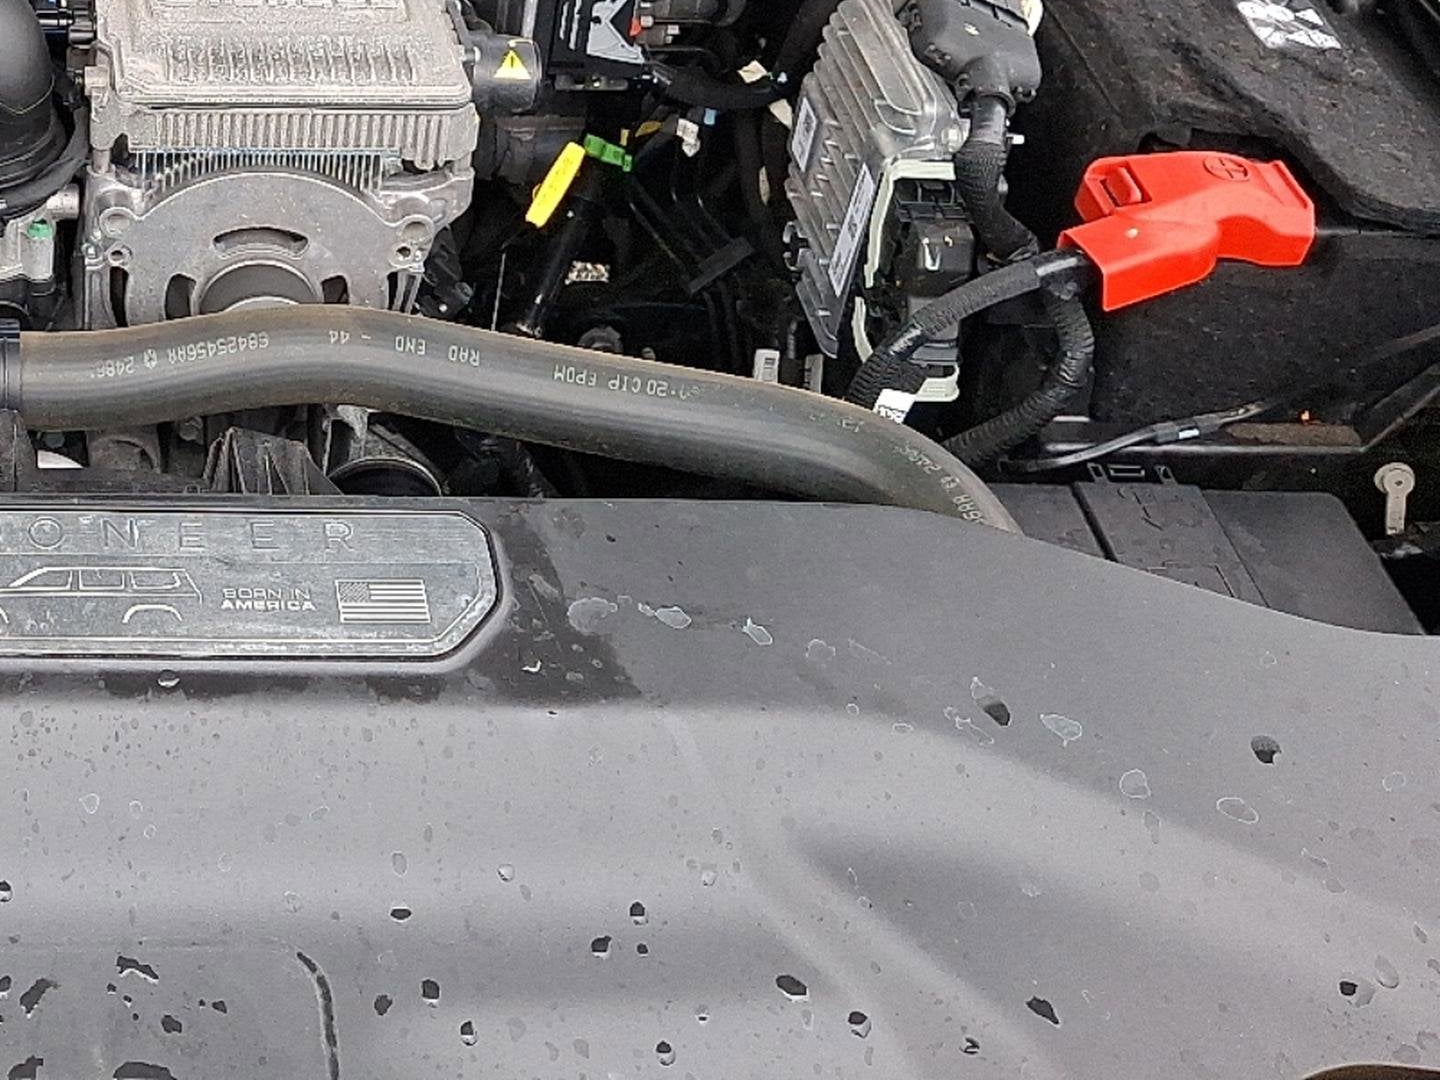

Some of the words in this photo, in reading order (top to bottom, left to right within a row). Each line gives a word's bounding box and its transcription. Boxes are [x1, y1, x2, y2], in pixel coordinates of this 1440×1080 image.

[394, 334, 427, 356] END
[447, 344, 481, 367] RAD
[222, 587, 282, 600] BORN
[291, 588, 312, 600] IN
[220, 598, 317, 612] AMERICA
